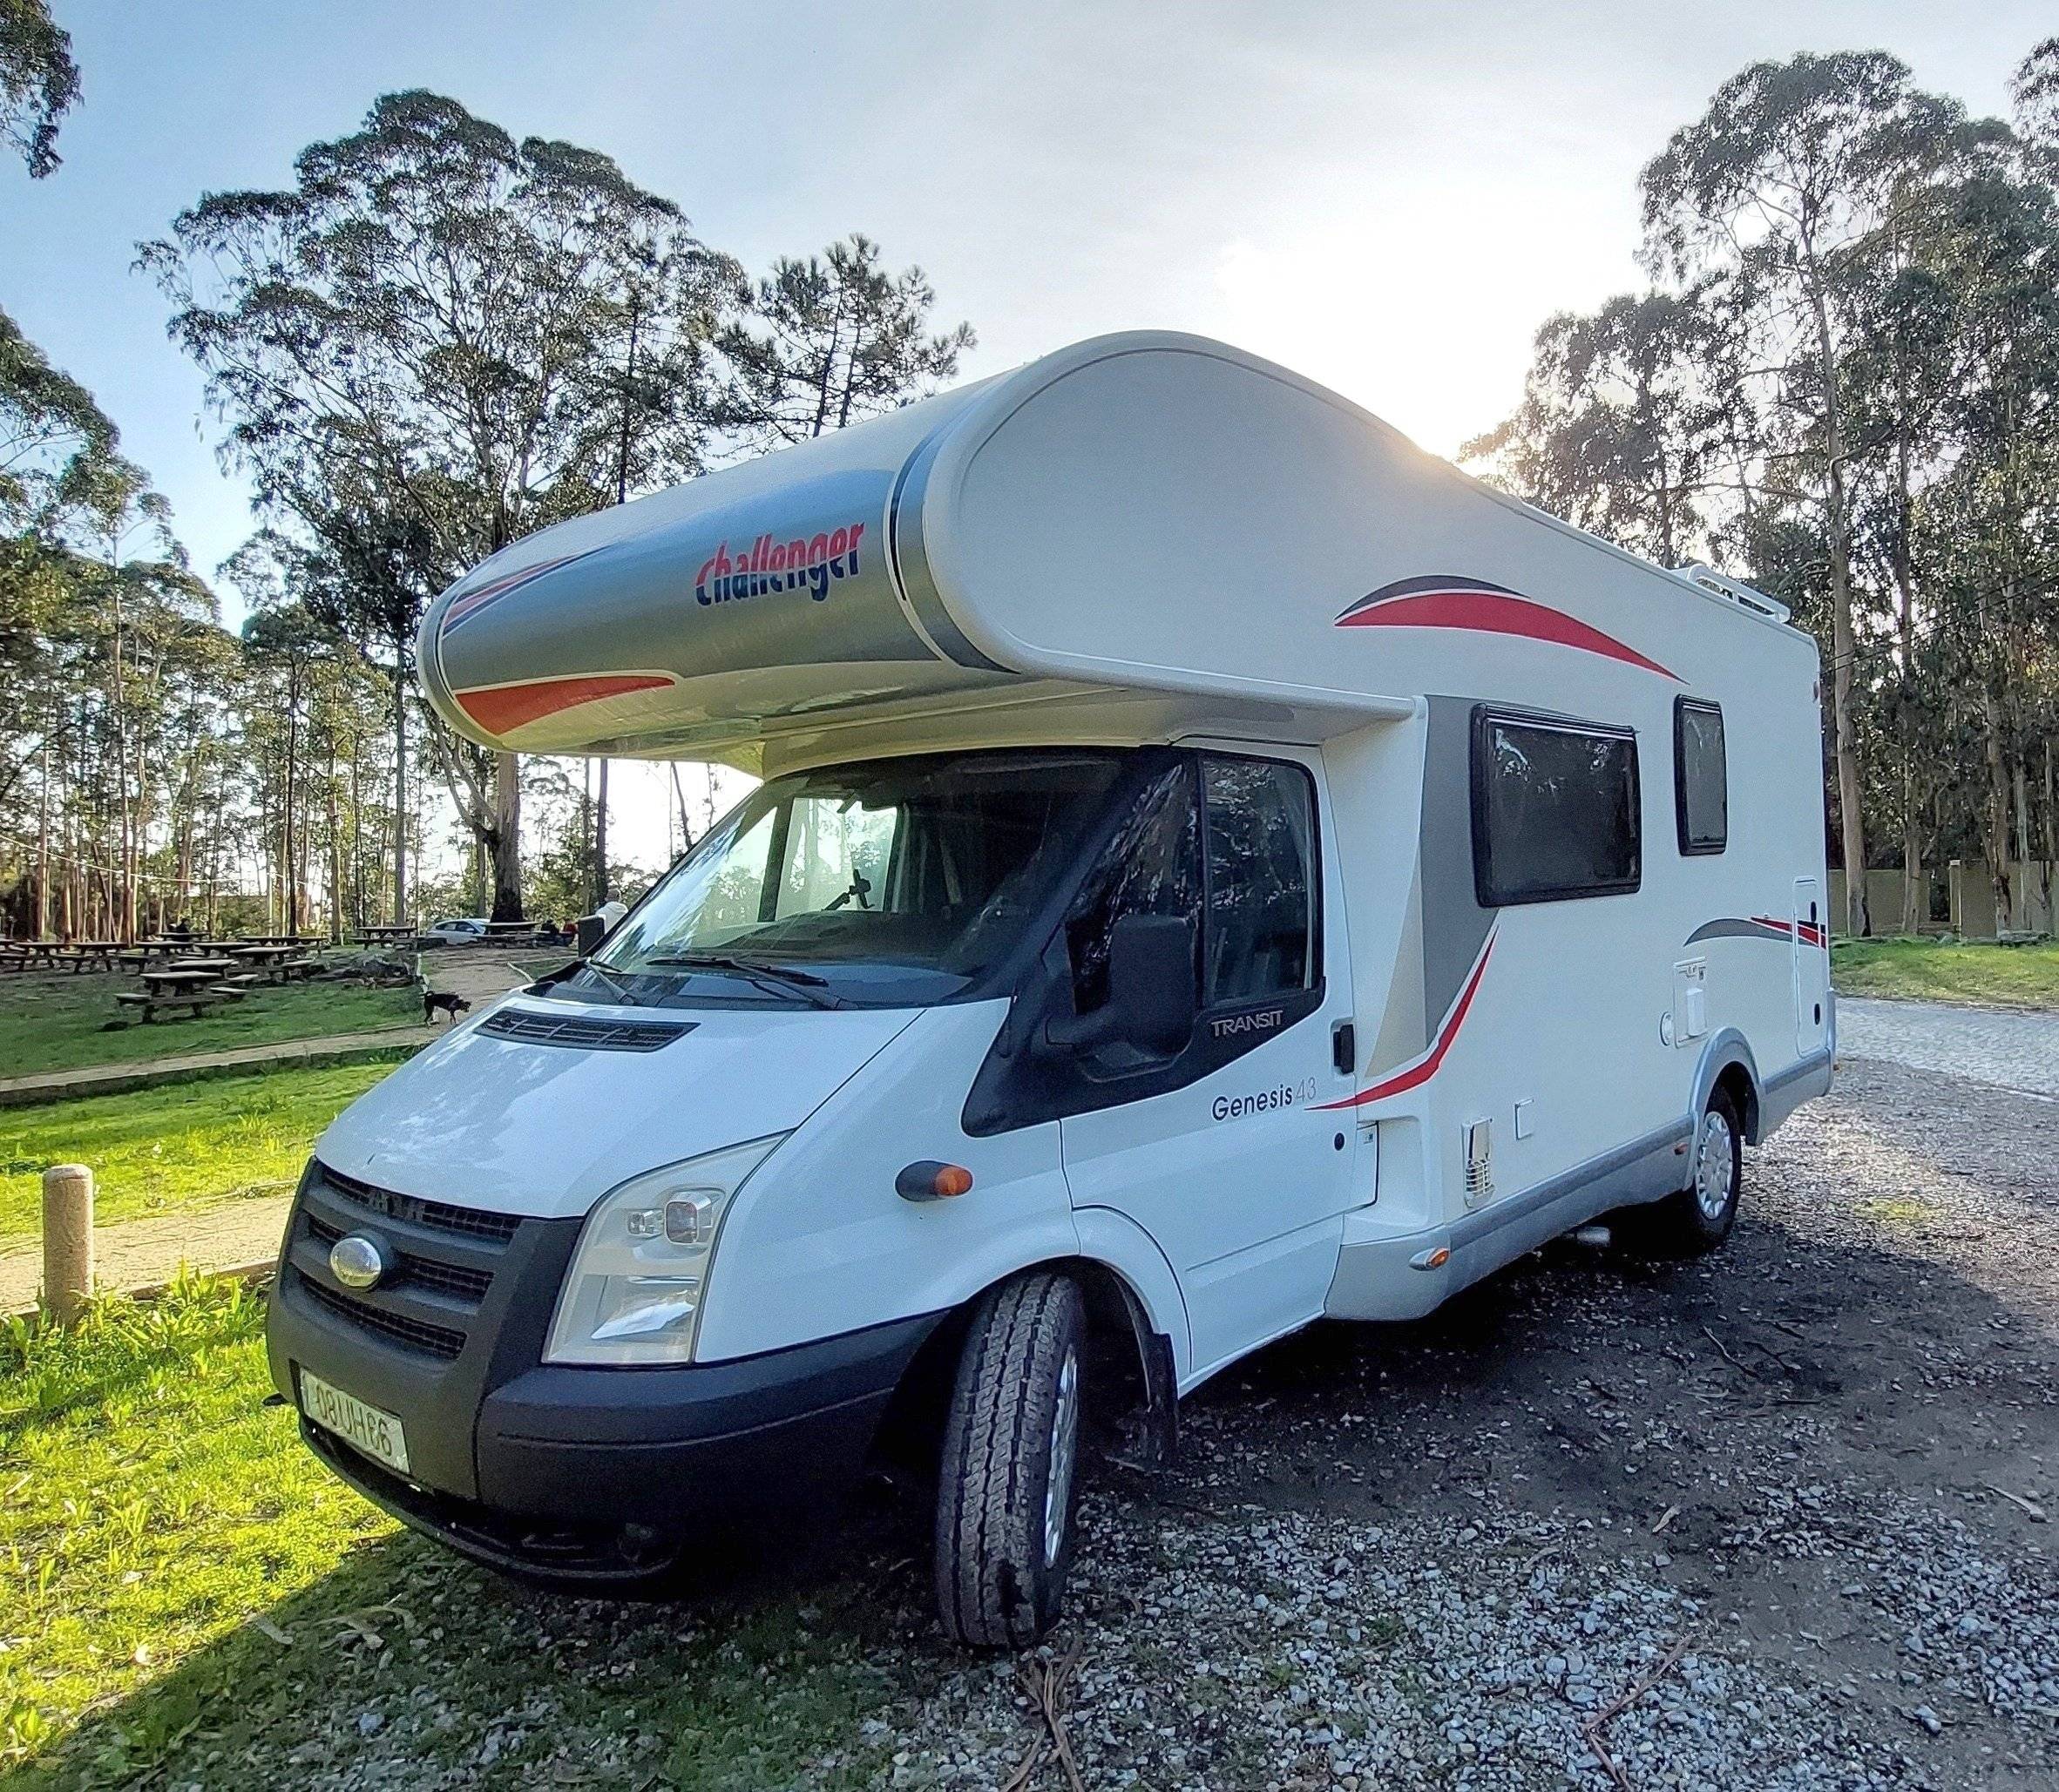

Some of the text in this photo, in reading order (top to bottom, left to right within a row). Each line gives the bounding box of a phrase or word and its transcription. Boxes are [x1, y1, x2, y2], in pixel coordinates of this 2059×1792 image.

[1211, 1010, 1283, 1038] TRANSIT
[1212, 1077, 1317, 1121] Genesis 43
